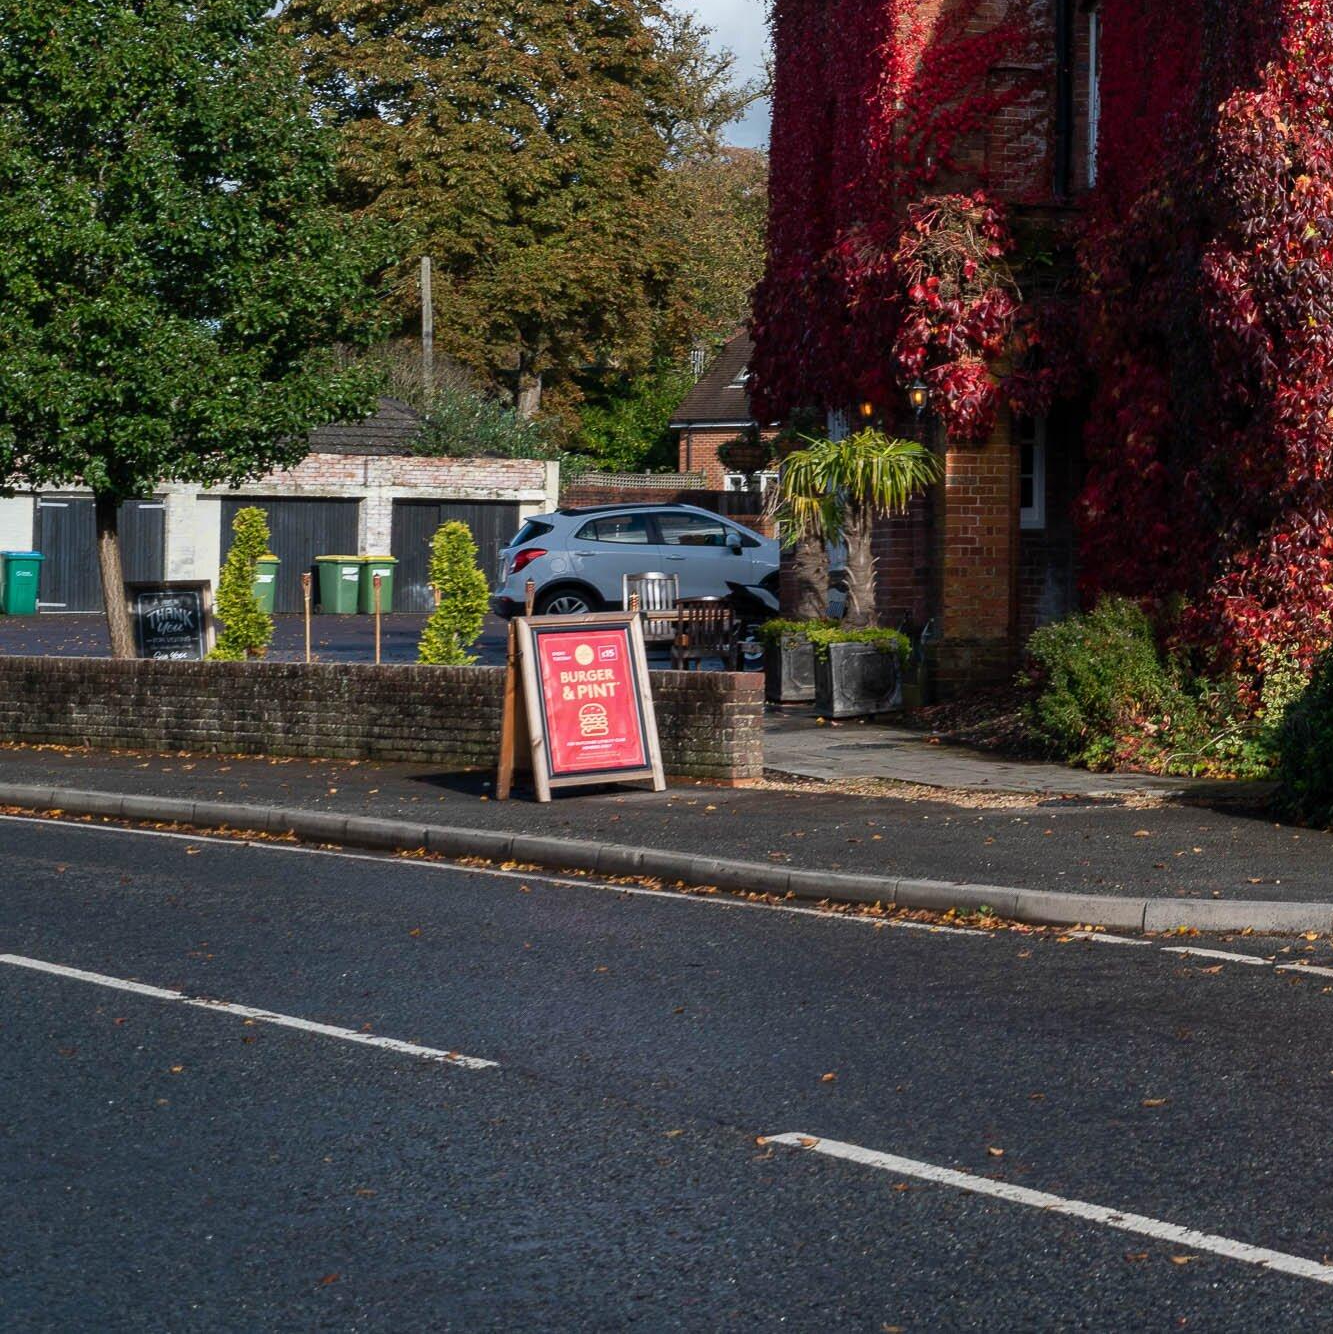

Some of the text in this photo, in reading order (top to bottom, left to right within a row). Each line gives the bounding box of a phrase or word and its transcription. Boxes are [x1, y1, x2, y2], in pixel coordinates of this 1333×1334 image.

[146, 607, 194, 629] THANK
[560, 668, 615, 683] BURGER
[562, 685, 575, 700] &
